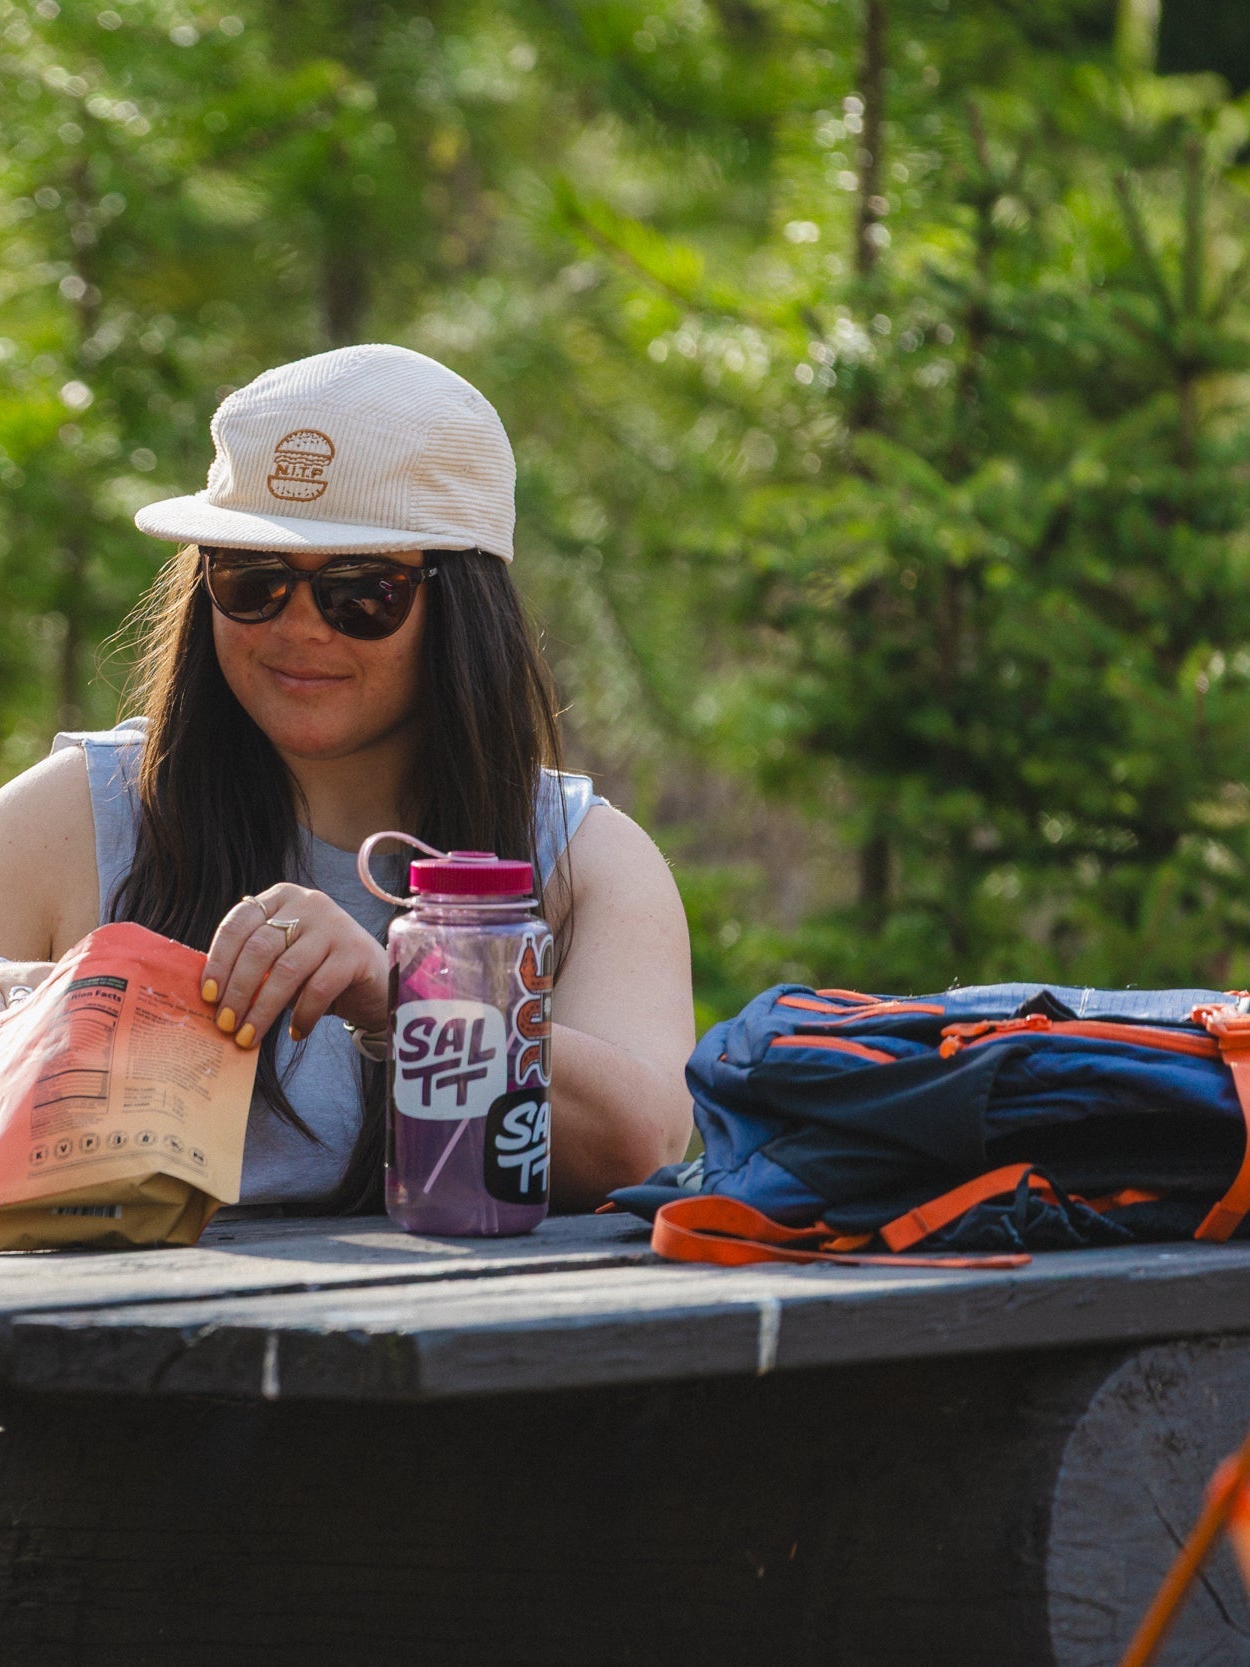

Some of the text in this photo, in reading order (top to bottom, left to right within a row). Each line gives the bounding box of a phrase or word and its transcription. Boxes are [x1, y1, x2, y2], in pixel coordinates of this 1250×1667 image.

[95, 990, 122, 1003] Facts
[398, 1016, 496, 1065] SAL
[401, 1057, 488, 1107] TT
[495, 1100, 549, 1150] SA
